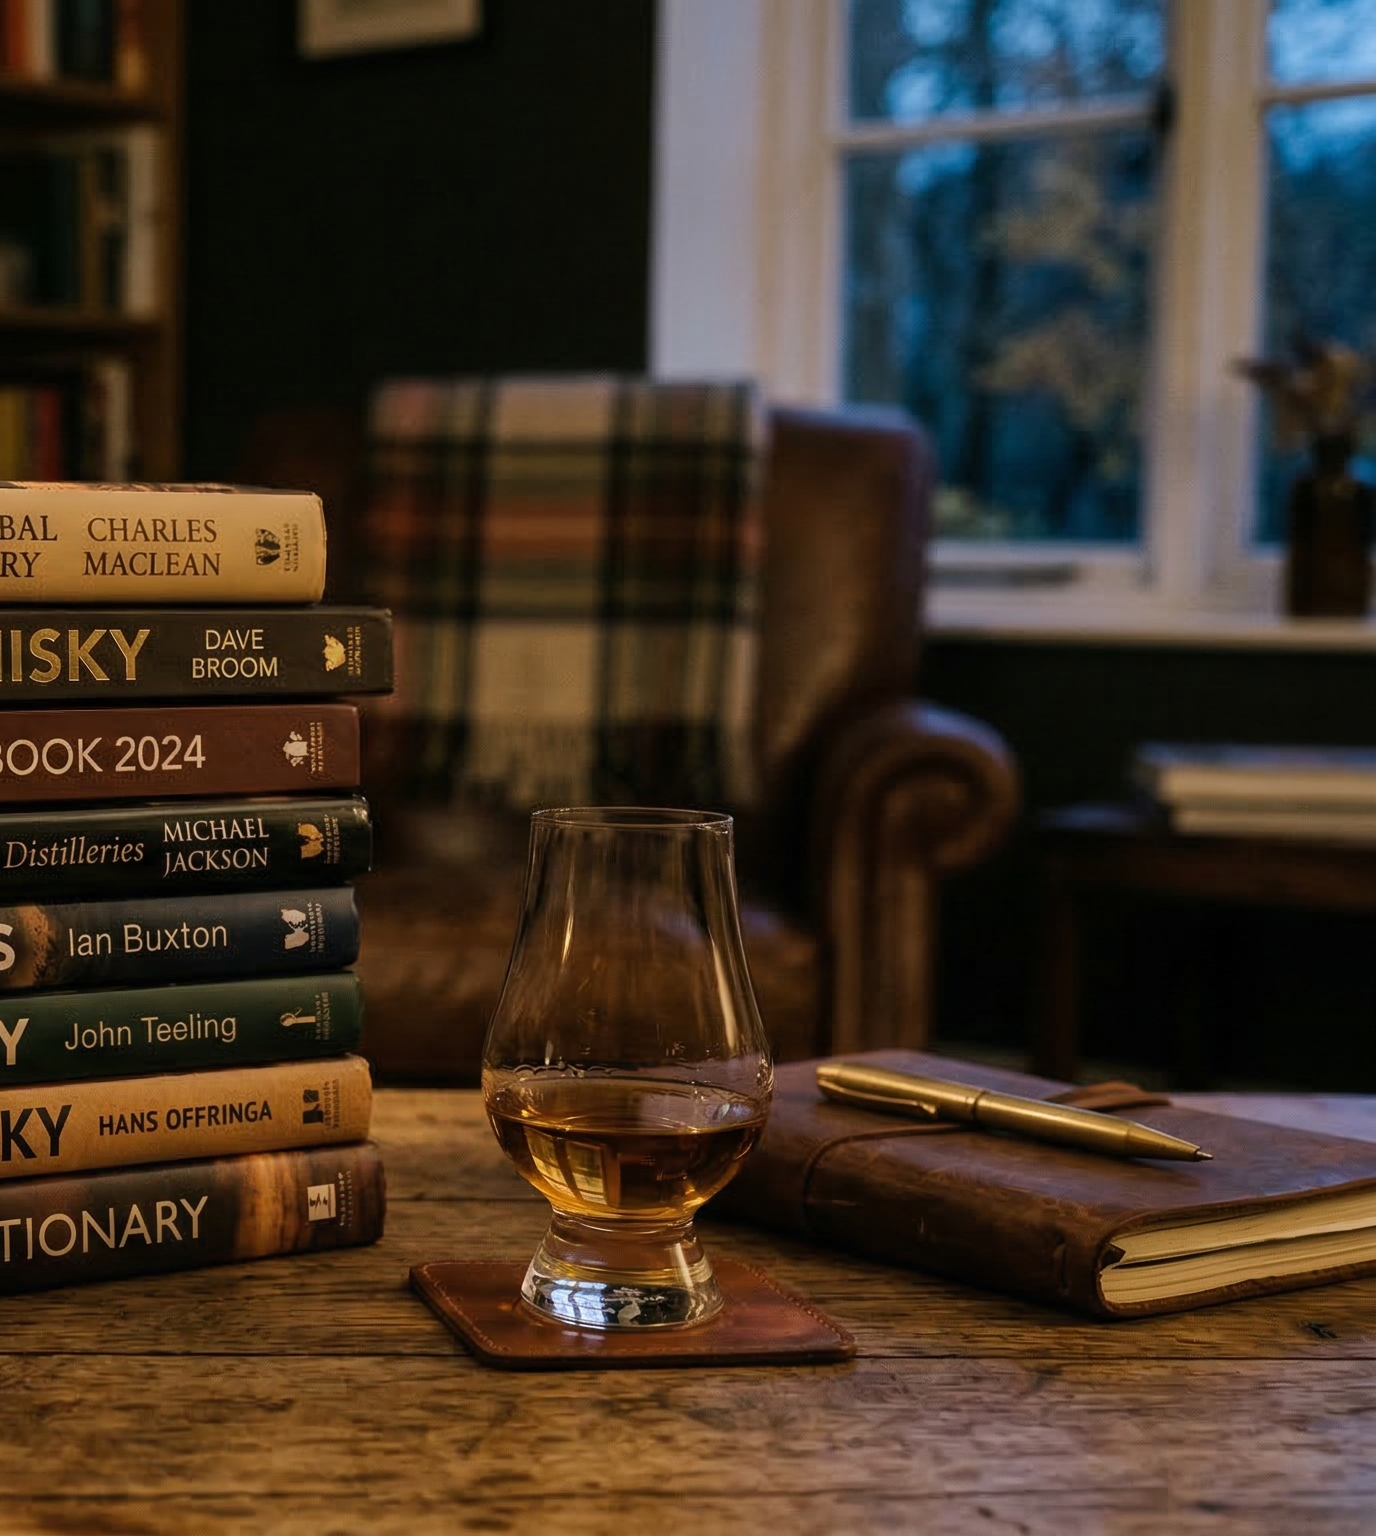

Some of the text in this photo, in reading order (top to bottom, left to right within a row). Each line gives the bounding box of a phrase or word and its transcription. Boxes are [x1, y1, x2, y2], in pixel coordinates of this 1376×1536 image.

[87, 517, 217, 543] CHARLES
[83, 552, 221, 577] MACLEAN
[205, 629, 264, 650] DAVE
[192, 657, 278, 679] BROOM
[115, 734, 206, 772] 2024
[163, 818, 269, 842] MICHAEL
[4, 837, 144, 870] Distilleries
[162, 847, 269, 878] JACKSON
[68, 921, 227, 958] Ian Buxton
[65, 1013, 237, 1050] John Teeling
[99, 1100, 272, 1136] HANS OFFRINGA
